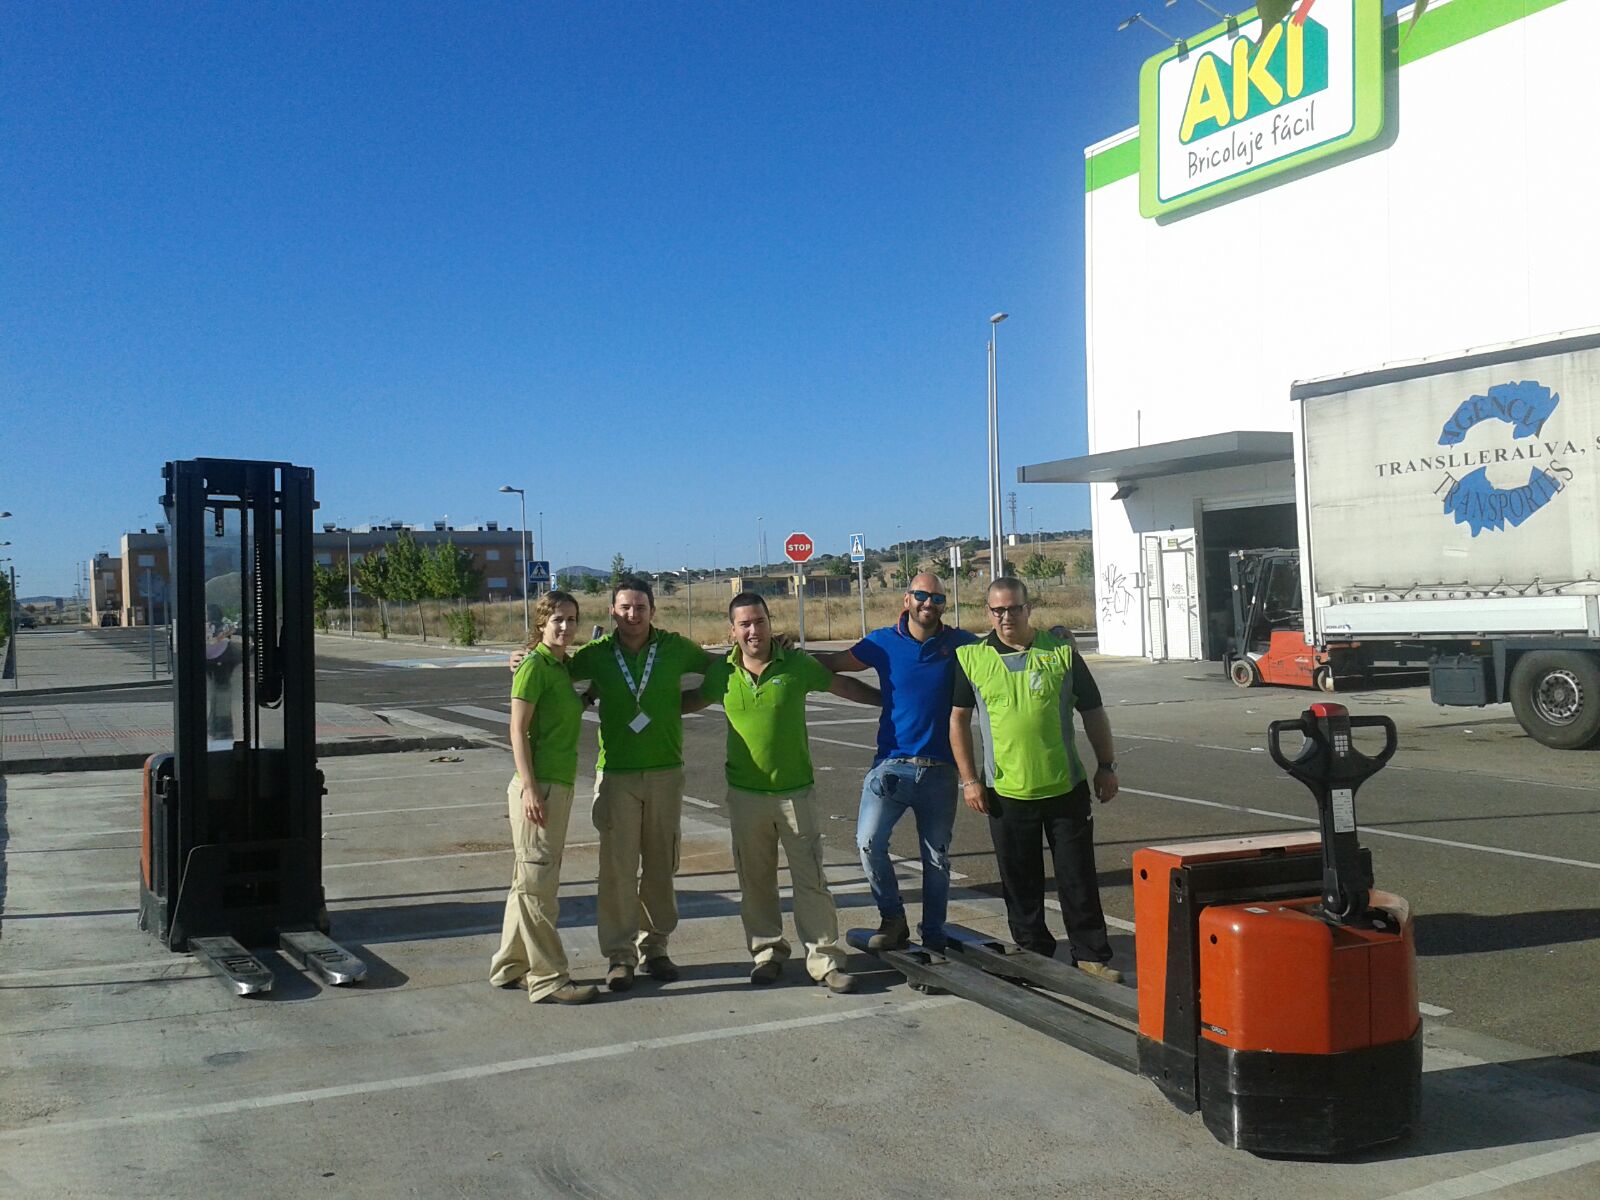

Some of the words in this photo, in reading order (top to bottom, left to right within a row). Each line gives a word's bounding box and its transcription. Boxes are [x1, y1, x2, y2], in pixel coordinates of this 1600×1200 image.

[1179, 14, 1304, 142] AKI
[1187, 131, 1263, 179] Bricolaje
[1271, 99, 1315, 145] fácil
[1375, 440, 1586, 478] TRANSLLERALVA,
[1433, 459, 1574, 523] TRANSPORTES
[788, 543, 811, 552] STOP
